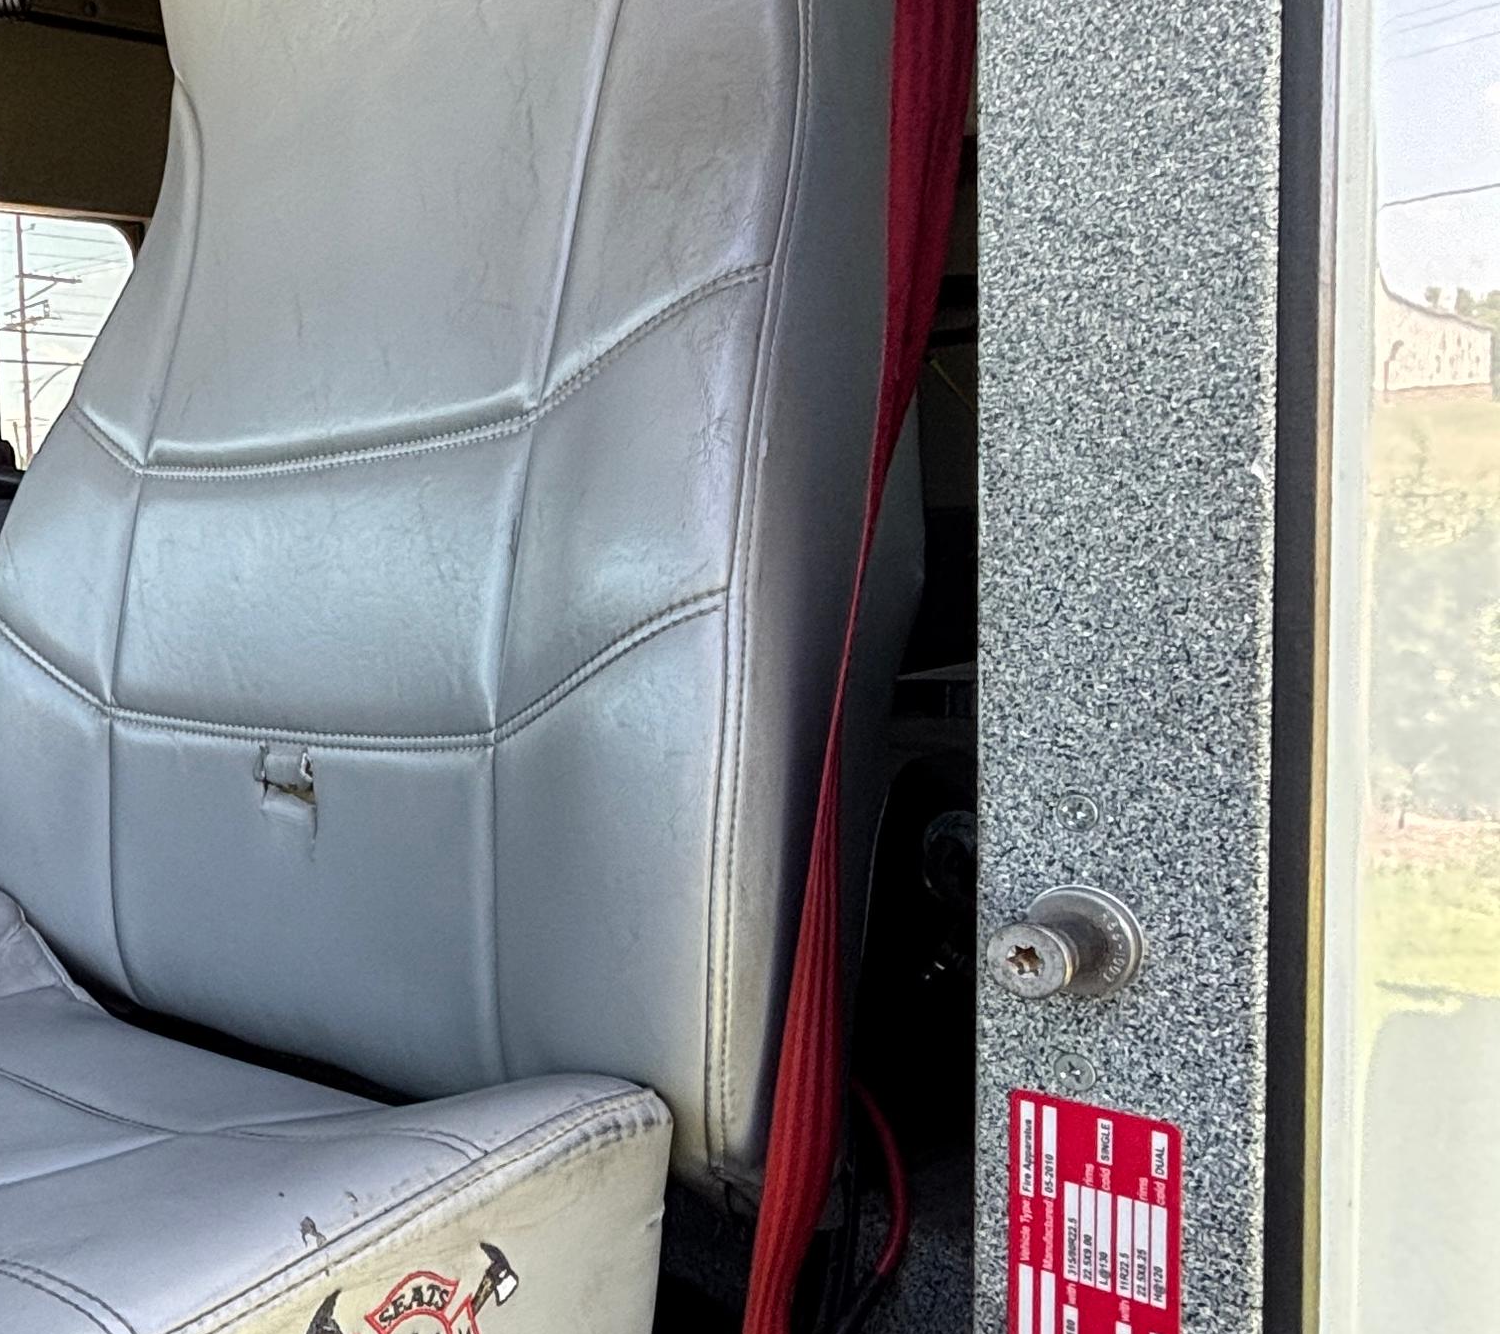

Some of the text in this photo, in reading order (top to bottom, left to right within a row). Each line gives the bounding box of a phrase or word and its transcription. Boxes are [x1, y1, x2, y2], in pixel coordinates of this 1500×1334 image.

[1023, 1119, 1033, 1171] Apparatus
[1101, 1123, 1110, 1161] SINGLE
[1045, 1154, 1054, 1193] 05-2010
[1084, 1164, 1094, 1185] rims
[1100, 1167, 1111, 1190] cold
[1155, 1147, 1165, 1175] DUAL
[1022, 1173, 1031, 1192] Fire
[1155, 1181, 1166, 1205] cold
[1020, 1225, 1031, 1261] Vehicle
[1043, 1199, 1054, 1270] Manufactured
[1137, 1178, 1148, 1297] 22.5X8.25 rims
[1120, 1253, 1129, 1291] 11R22.5
[379, 1284, 449, 1329] SEATS
[1066, 1283, 1077, 1305] with
[1119, 1300, 1130, 1322] with
